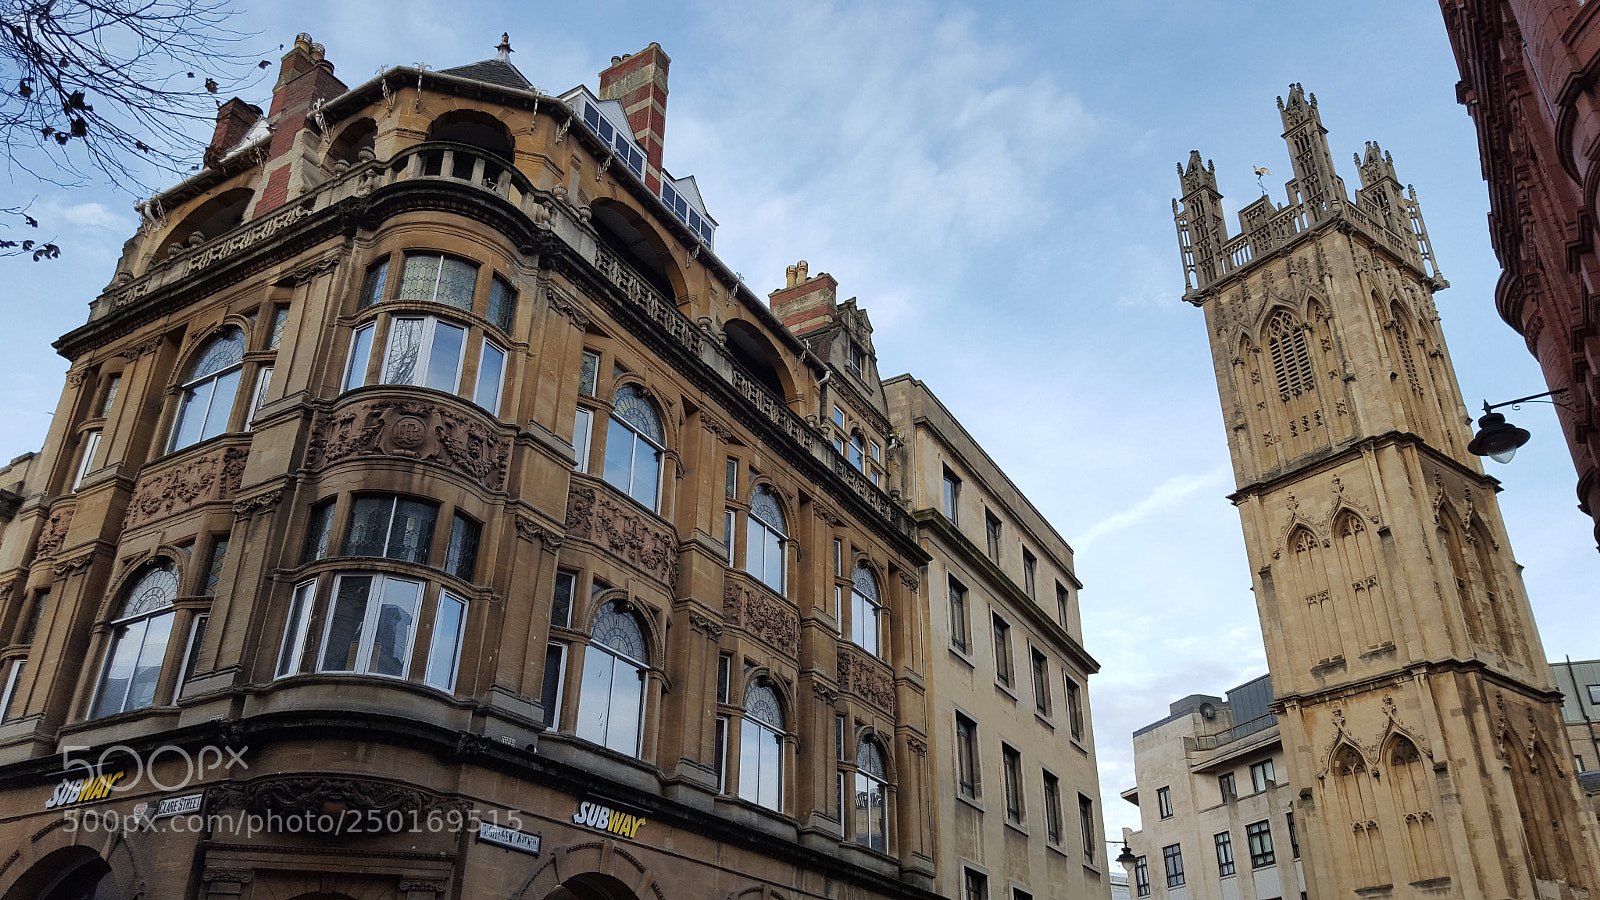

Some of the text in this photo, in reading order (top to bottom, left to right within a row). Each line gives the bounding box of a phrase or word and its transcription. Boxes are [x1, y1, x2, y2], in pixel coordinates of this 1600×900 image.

[45, 770, 124, 809] SUBWAY
[159, 796, 202, 814] CLARE STREET
[573, 801, 647, 838] SUBWAY
